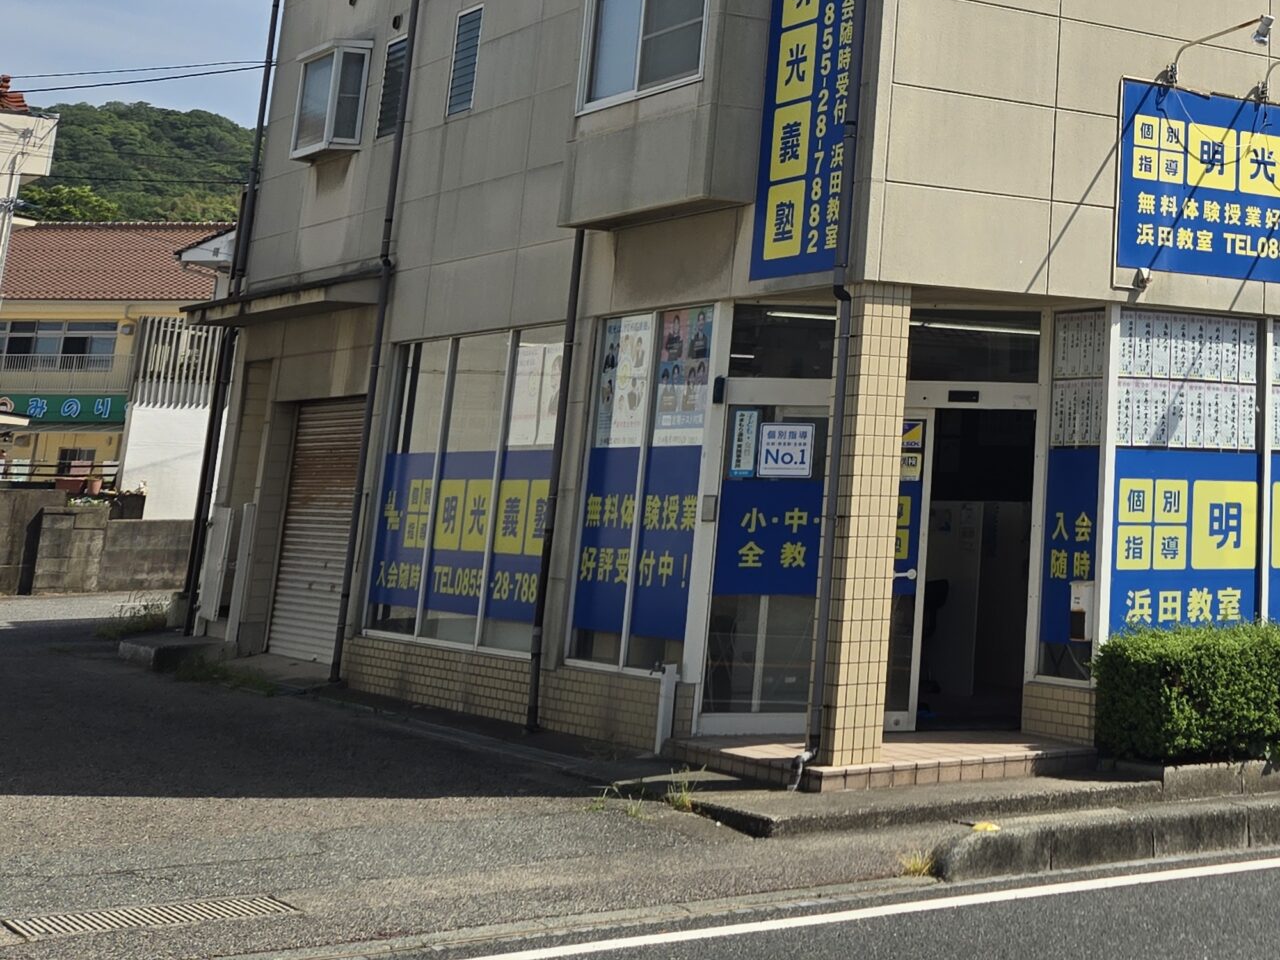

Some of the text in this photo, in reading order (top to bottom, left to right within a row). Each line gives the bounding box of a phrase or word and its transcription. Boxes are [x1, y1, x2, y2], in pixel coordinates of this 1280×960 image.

[1140, 122, 1180, 144] 個別
[1139, 156, 1178, 176] 指導
[1136, 223, 1213, 253] 浜田教室
[27, 398, 129, 418] みのり
[765, 448, 806, 465] No.1
[1127, 488, 1181, 514] 個別
[1052, 512, 1092, 542] 入会
[1124, 535, 1179, 560] 指導
[1050, 549, 1090, 580] 随時
[1126, 587, 1242, 623] 浜田教室
